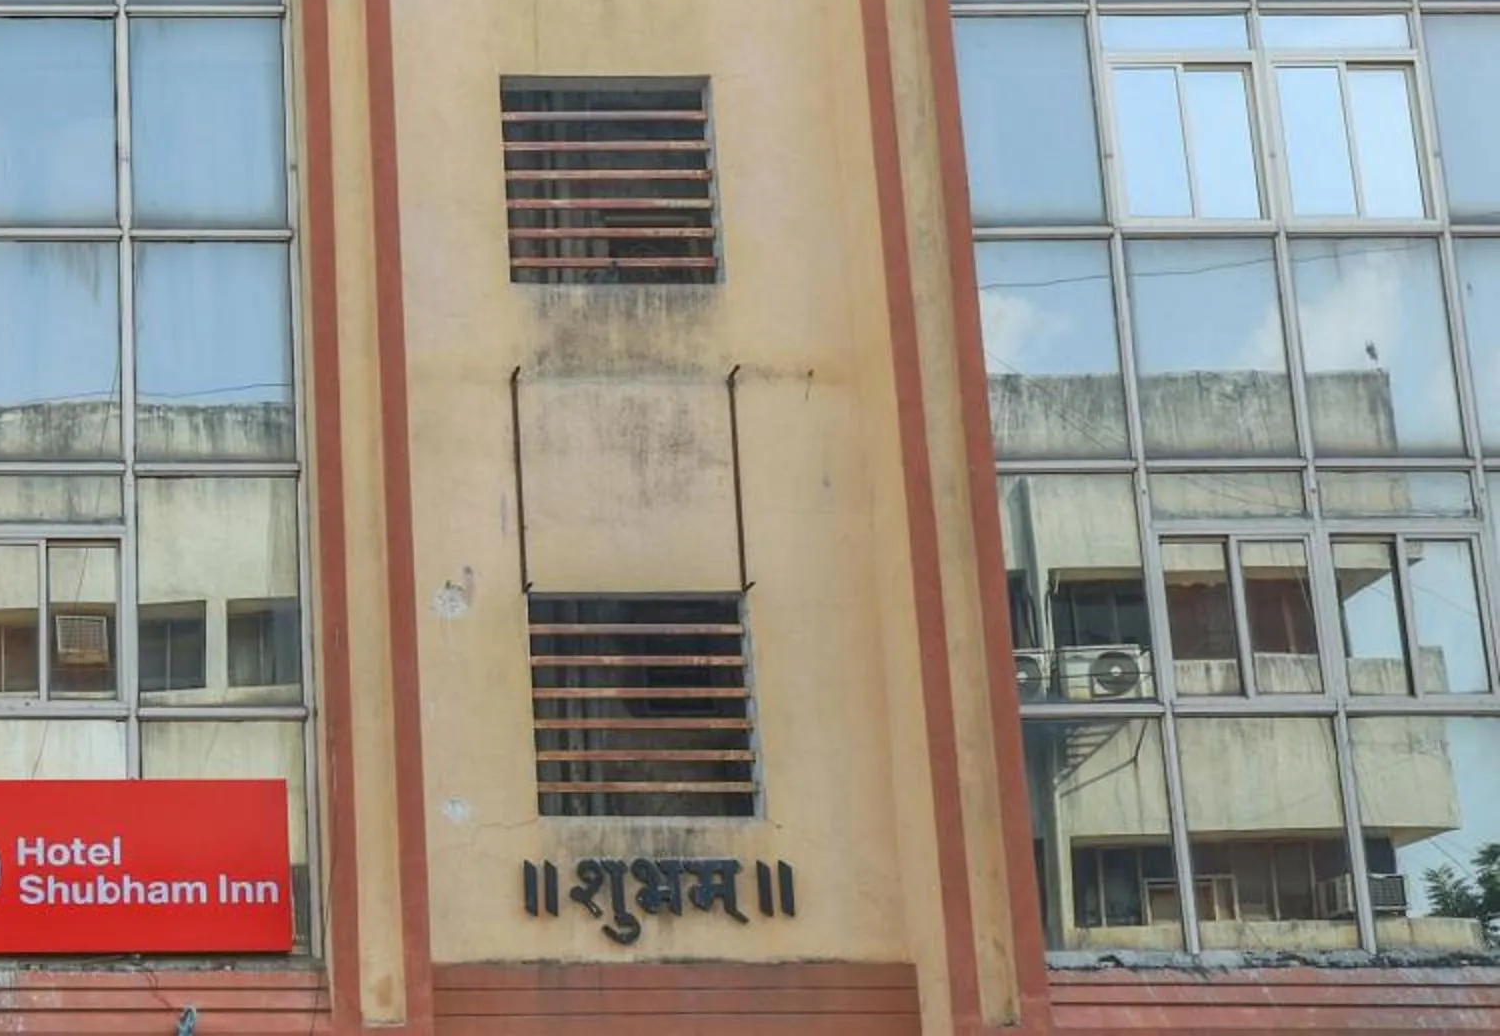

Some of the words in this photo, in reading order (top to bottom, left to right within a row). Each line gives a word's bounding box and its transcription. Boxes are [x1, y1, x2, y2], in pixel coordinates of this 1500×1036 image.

[16, 837, 122, 867] Hotel
[18, 875, 209, 907] Shubham
[219, 875, 279, 905] Inn
